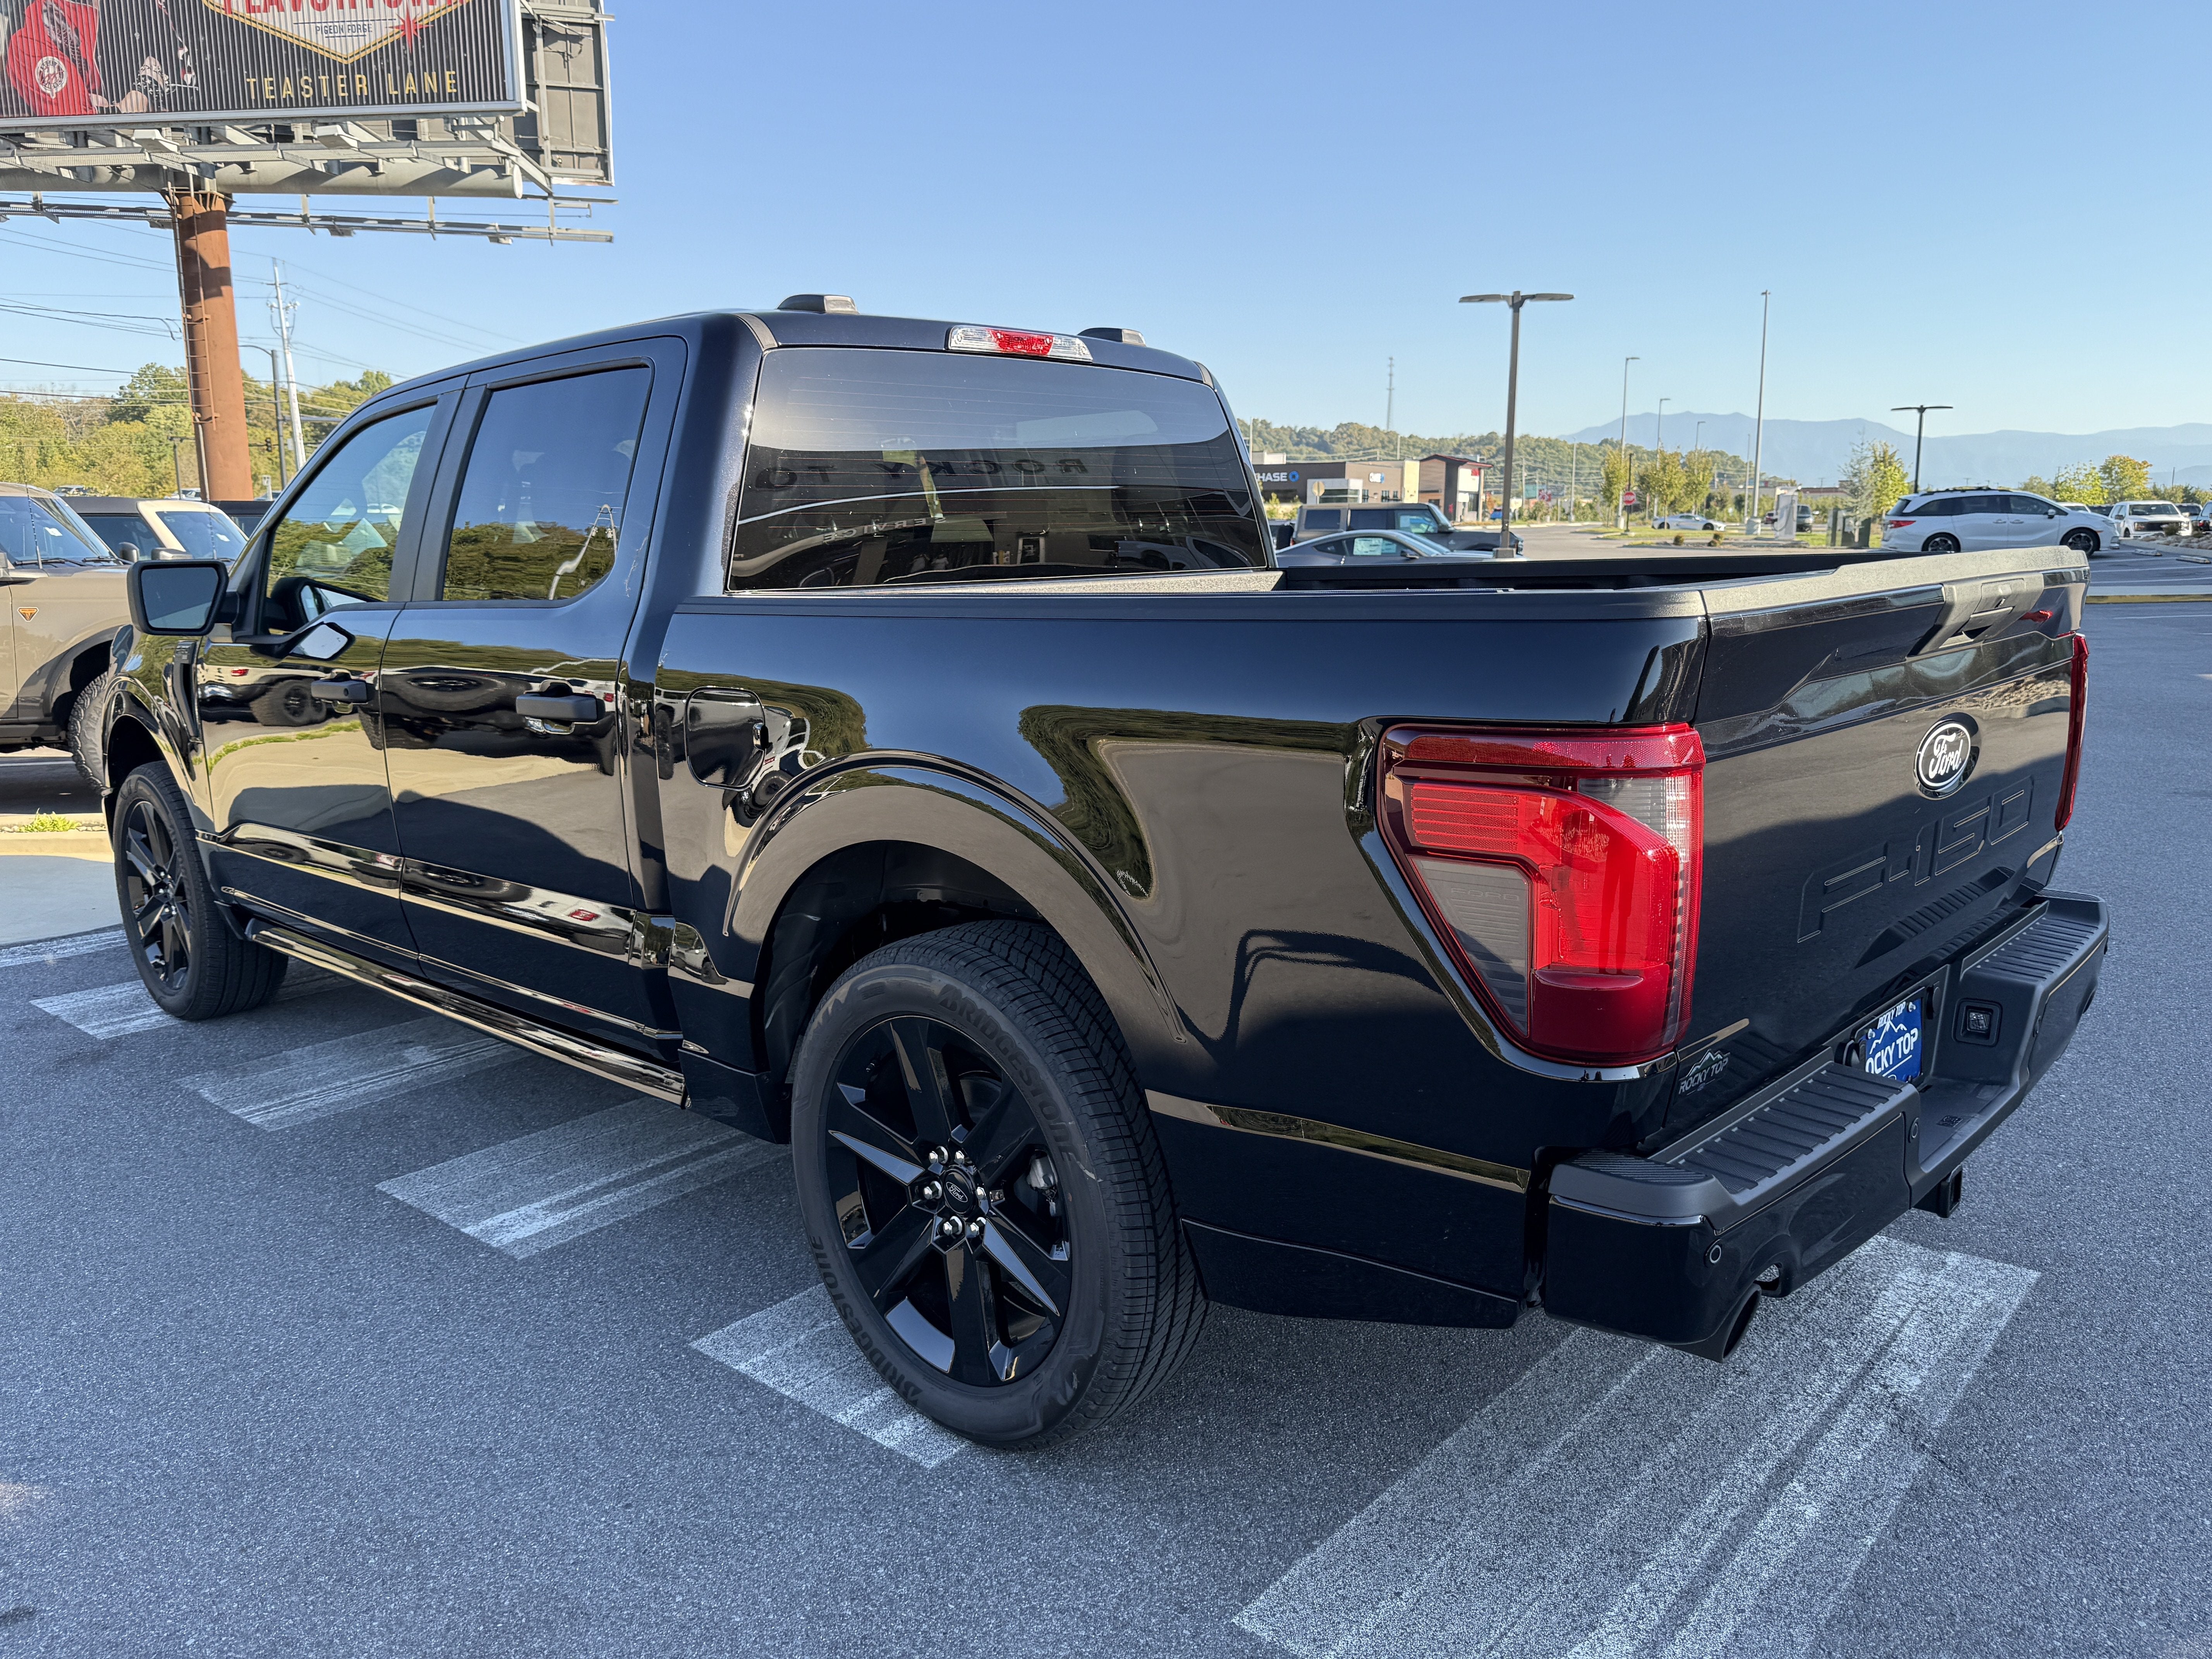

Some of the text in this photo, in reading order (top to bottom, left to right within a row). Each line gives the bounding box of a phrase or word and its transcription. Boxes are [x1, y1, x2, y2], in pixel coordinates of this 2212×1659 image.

[315, 24, 373, 34] PIGEON FORGE
[246, 71, 457, 99] TEASTER LANE
[1255, 472, 1288, 481] HASE
[1929, 732, 1963, 779] Ford
[1798, 776, 2034, 943] F-150
[1451, 888, 1520, 901] FORD
[1896, 1001, 1906, 1017] TOP
[1865, 1028, 1918, 1074] OCKY TOP
[938, 984, 1080, 1163] BRIDGESTONE
[1678, 1057, 1728, 1094] ROCKY TOP
[949, 1185, 964, 1200] Ford
[809, 1235, 924, 1405] BRIDGESTONE
